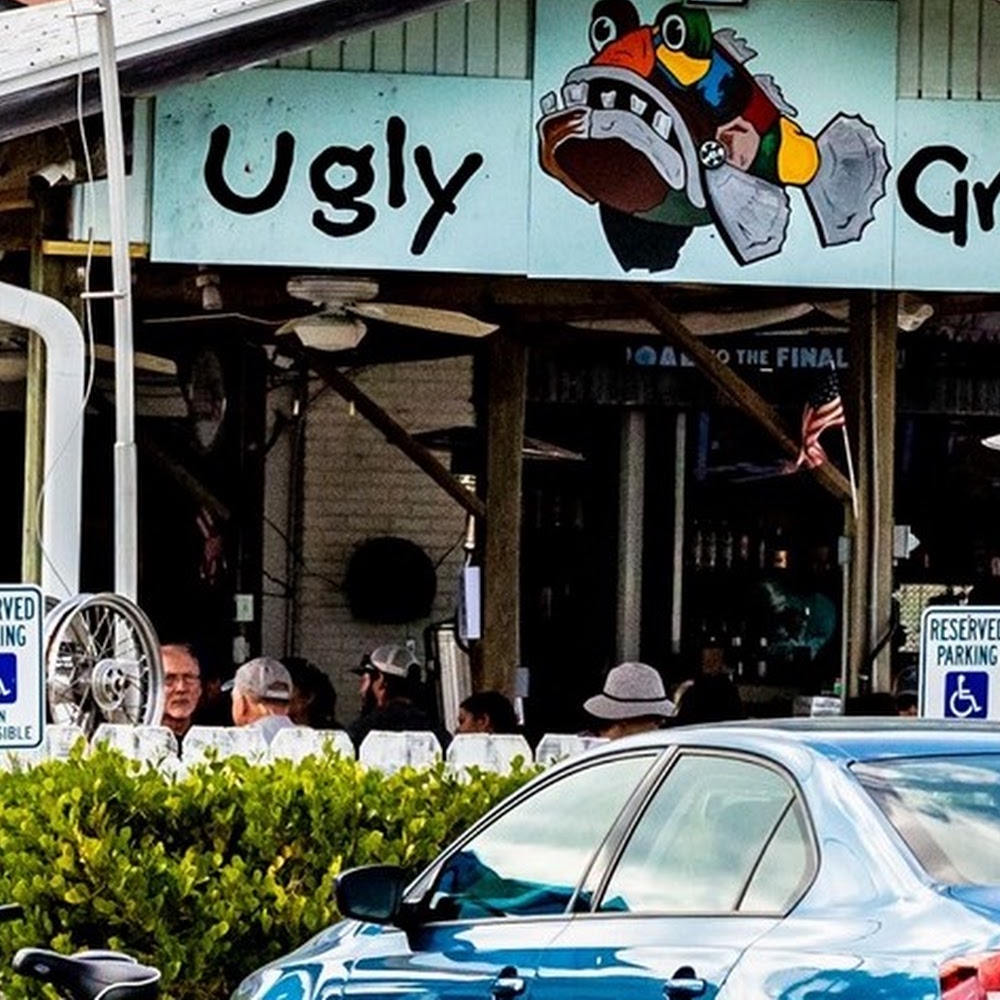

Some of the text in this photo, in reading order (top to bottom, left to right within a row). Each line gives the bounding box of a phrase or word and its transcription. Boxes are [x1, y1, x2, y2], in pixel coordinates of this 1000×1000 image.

[204, 117, 483, 255] Ugly
[626, 345, 696, 367] OA
[736, 349, 769, 365] THE
[776, 347, 848, 369] FINAL
[0, 597, 35, 620] VED
[937, 645, 998, 666] PARKING
